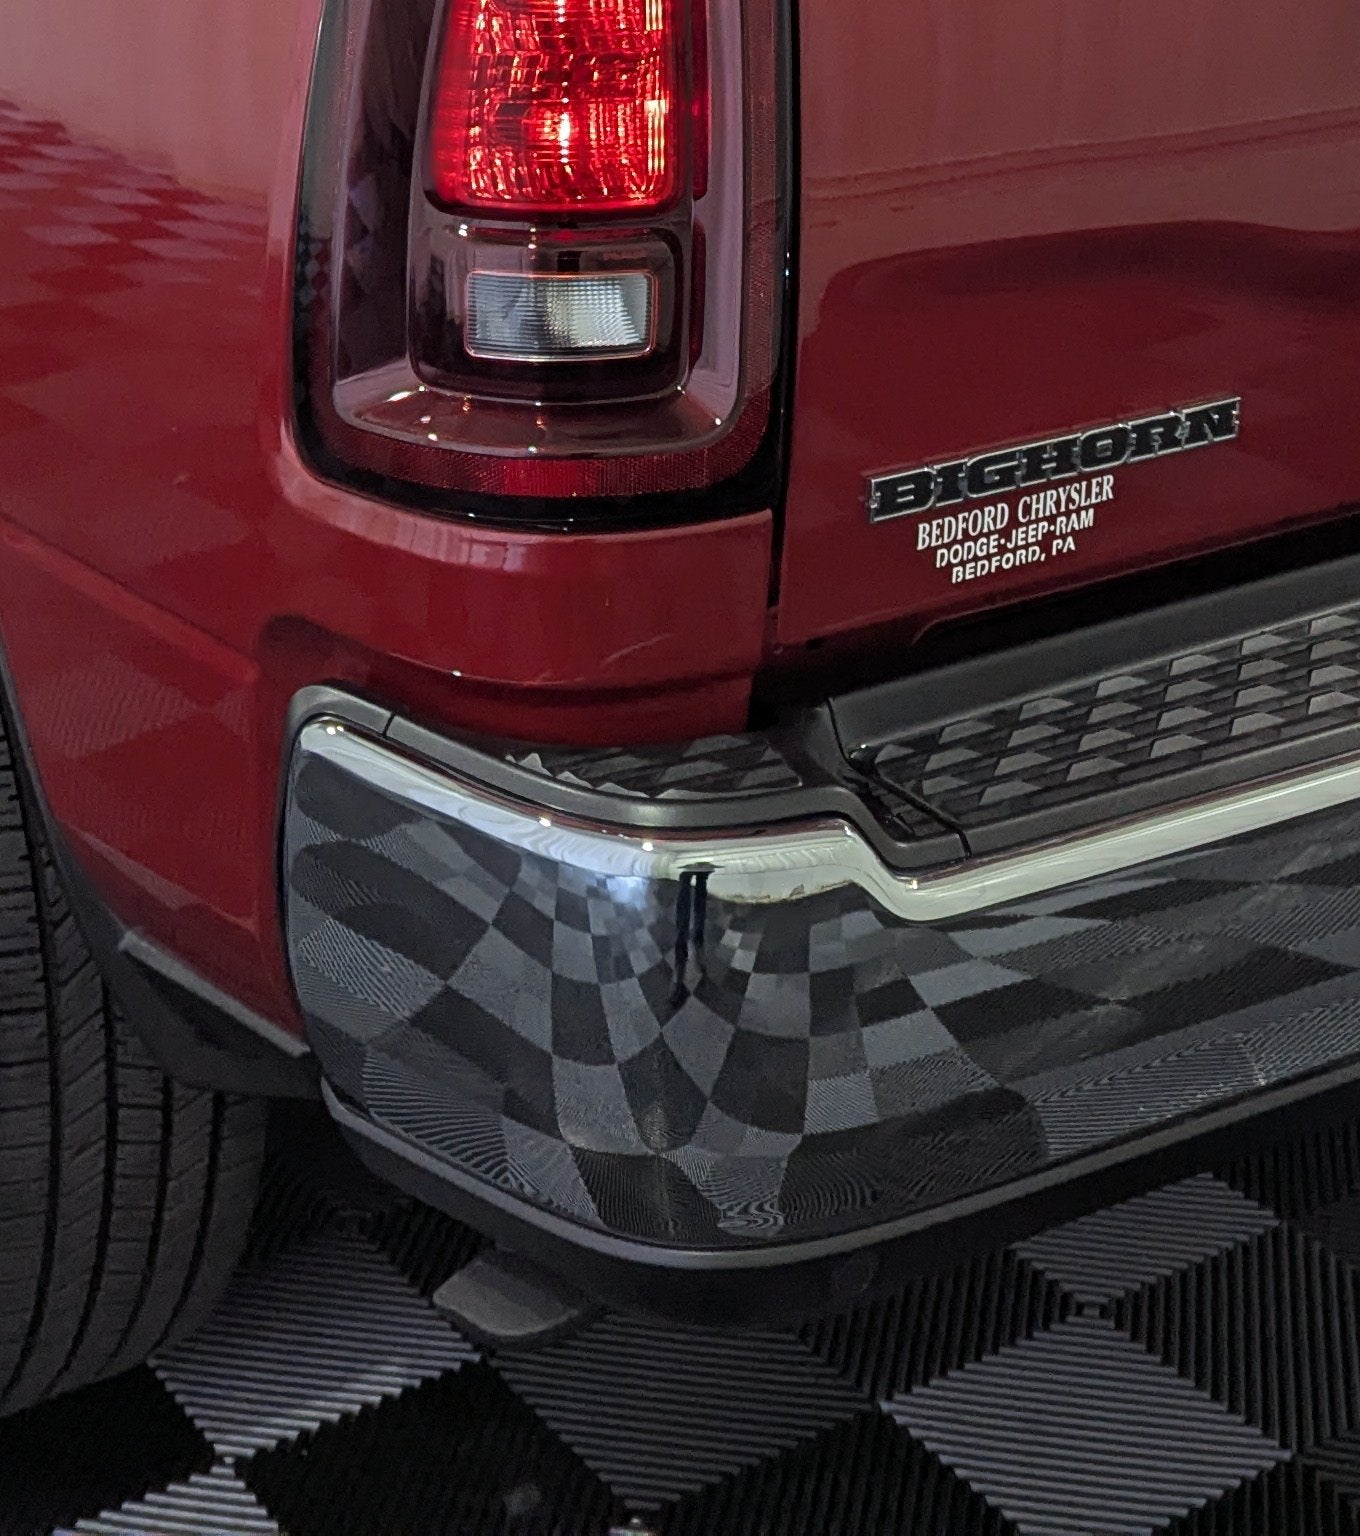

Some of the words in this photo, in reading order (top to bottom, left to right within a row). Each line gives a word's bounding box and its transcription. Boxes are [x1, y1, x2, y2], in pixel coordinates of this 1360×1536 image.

[916, 502, 1010, 551] BEDFORD
[1017, 474, 1114, 523] CHRYSLER
[951, 549, 1047, 585] BEDFORD,
[1051, 536, 1076, 555] PA
